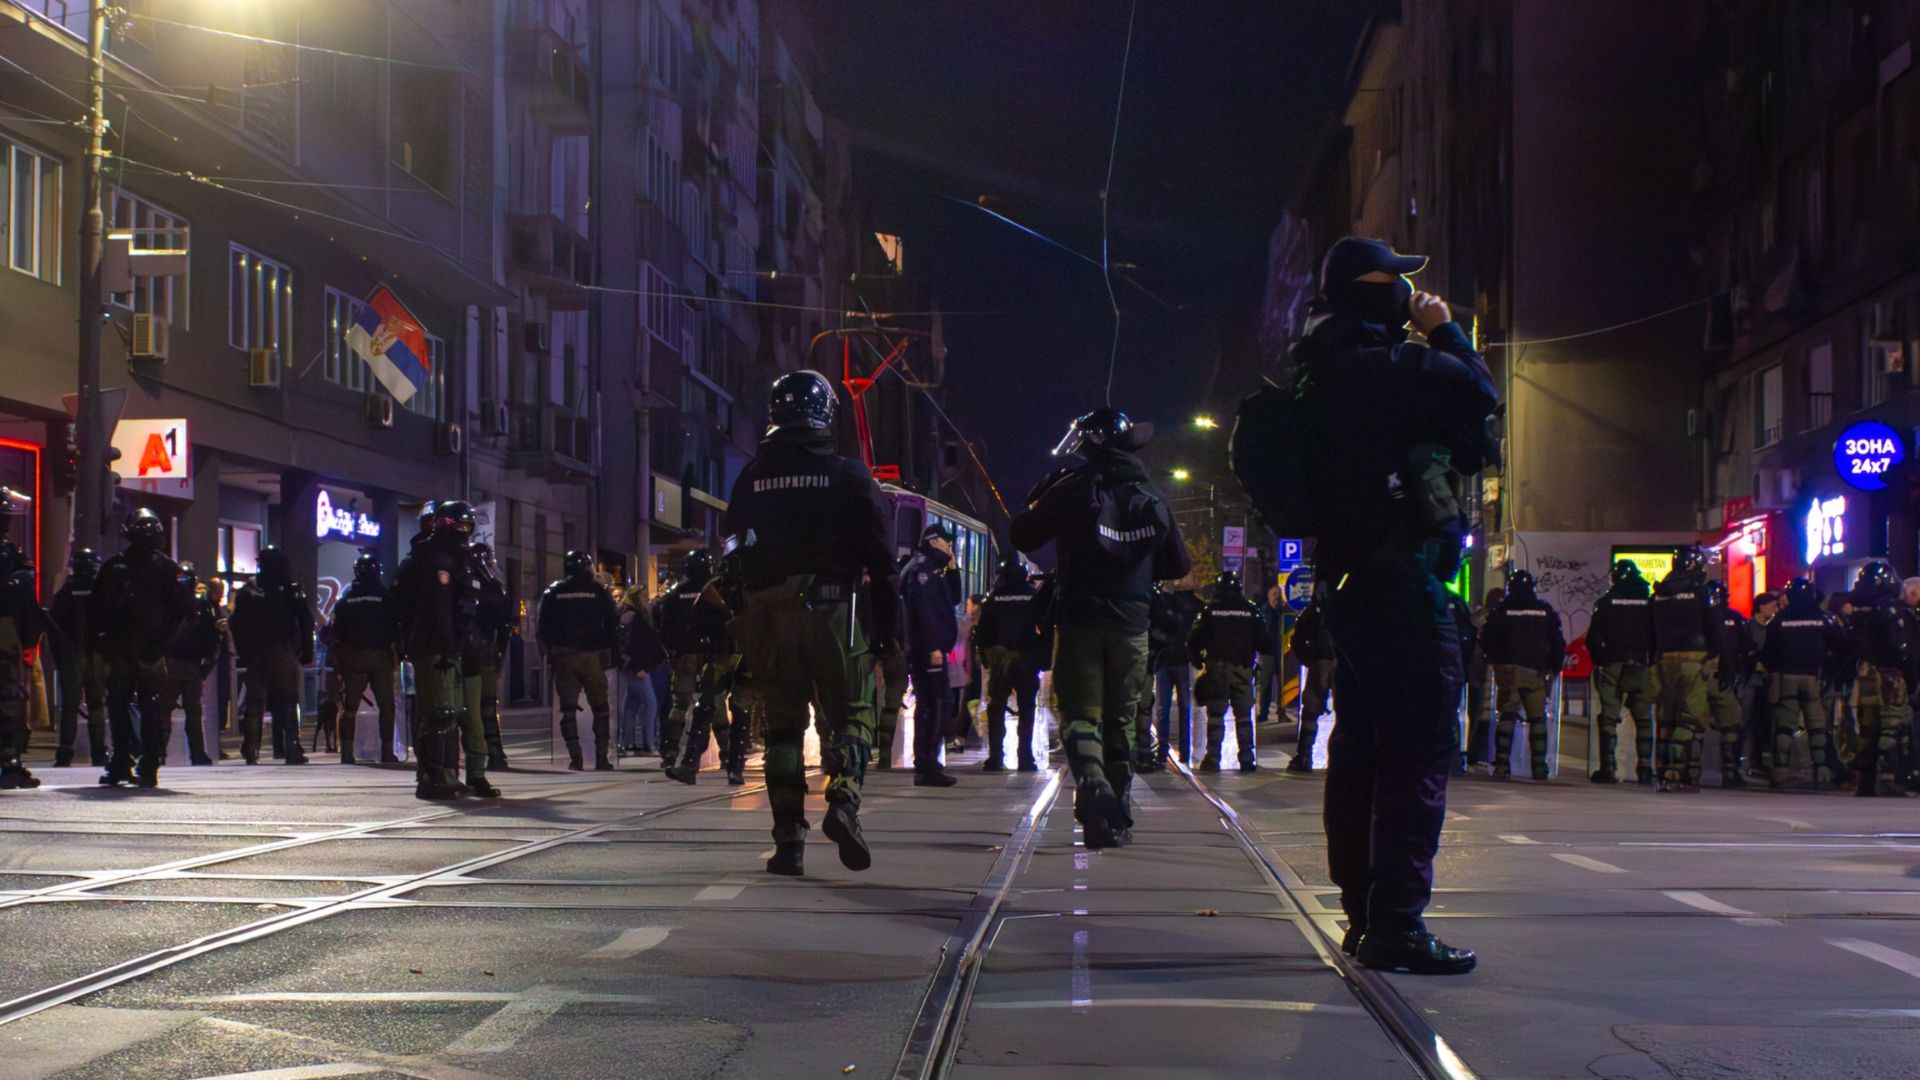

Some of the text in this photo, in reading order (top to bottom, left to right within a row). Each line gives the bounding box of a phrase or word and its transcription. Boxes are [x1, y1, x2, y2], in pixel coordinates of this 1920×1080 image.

[138, 428, 177, 476] A1
[1845, 438, 1896, 455] ЗОНА
[1851, 457, 1891, 474] 24x7
[1285, 542, 1298, 559] P
